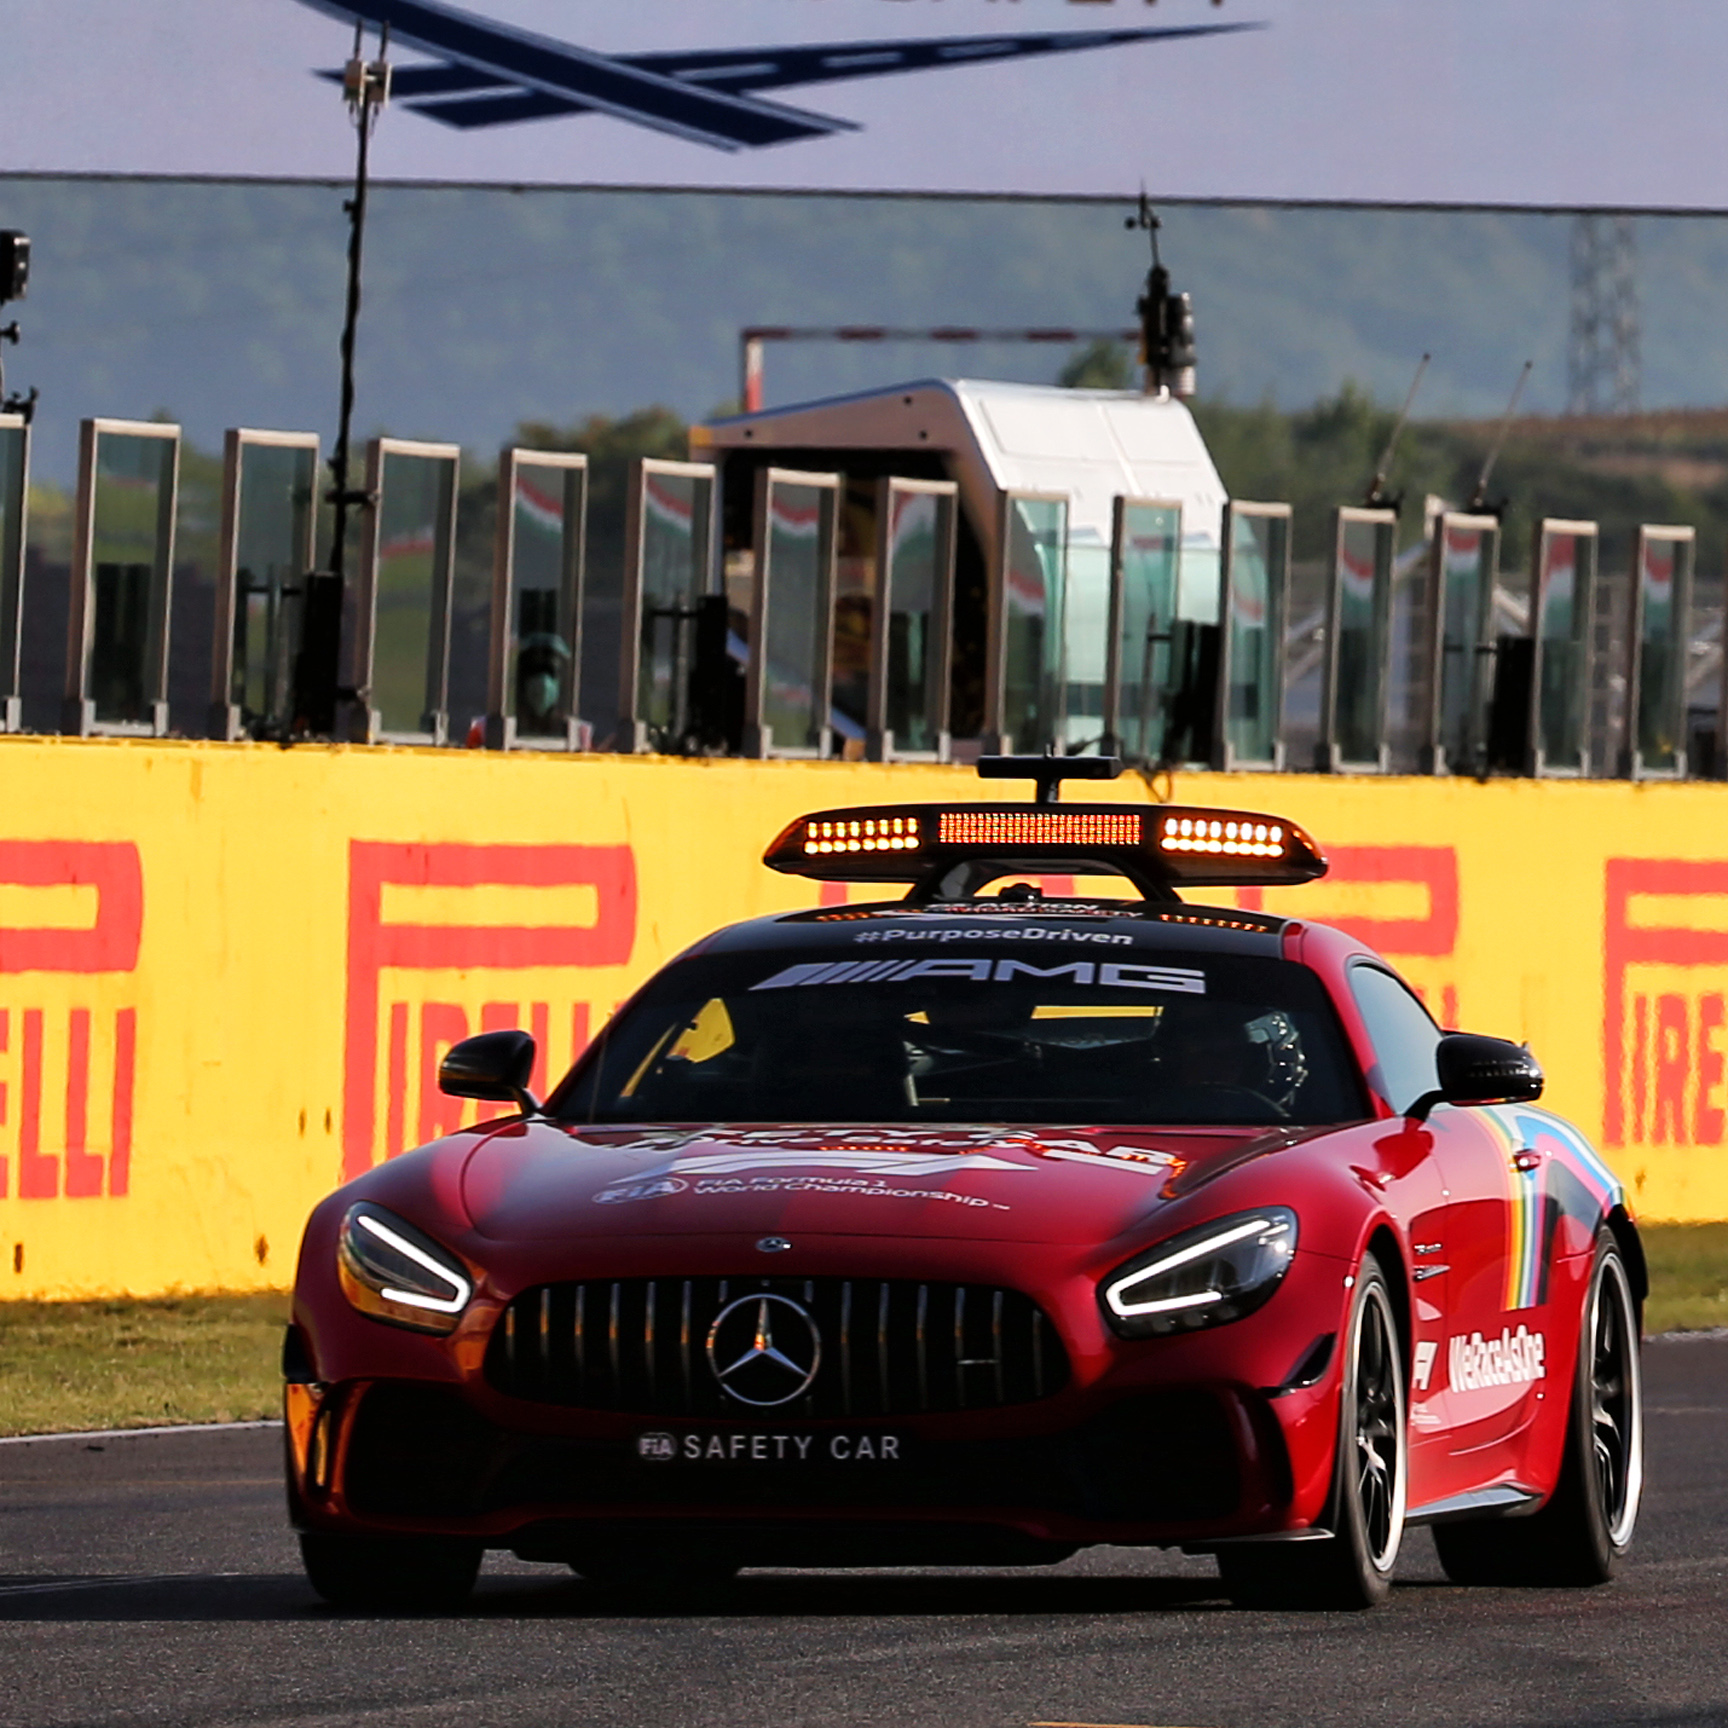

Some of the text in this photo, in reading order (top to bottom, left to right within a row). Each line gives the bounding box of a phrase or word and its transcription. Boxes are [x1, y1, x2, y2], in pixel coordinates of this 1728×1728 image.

[854, 927, 1133, 946] #PurposeDriven
[895, 959, 1206, 994] AMG
[693, 1182, 991, 1209] World Championship
[684, 1434, 813, 1460] SAFETY
[829, 1434, 900, 1460] CAR
